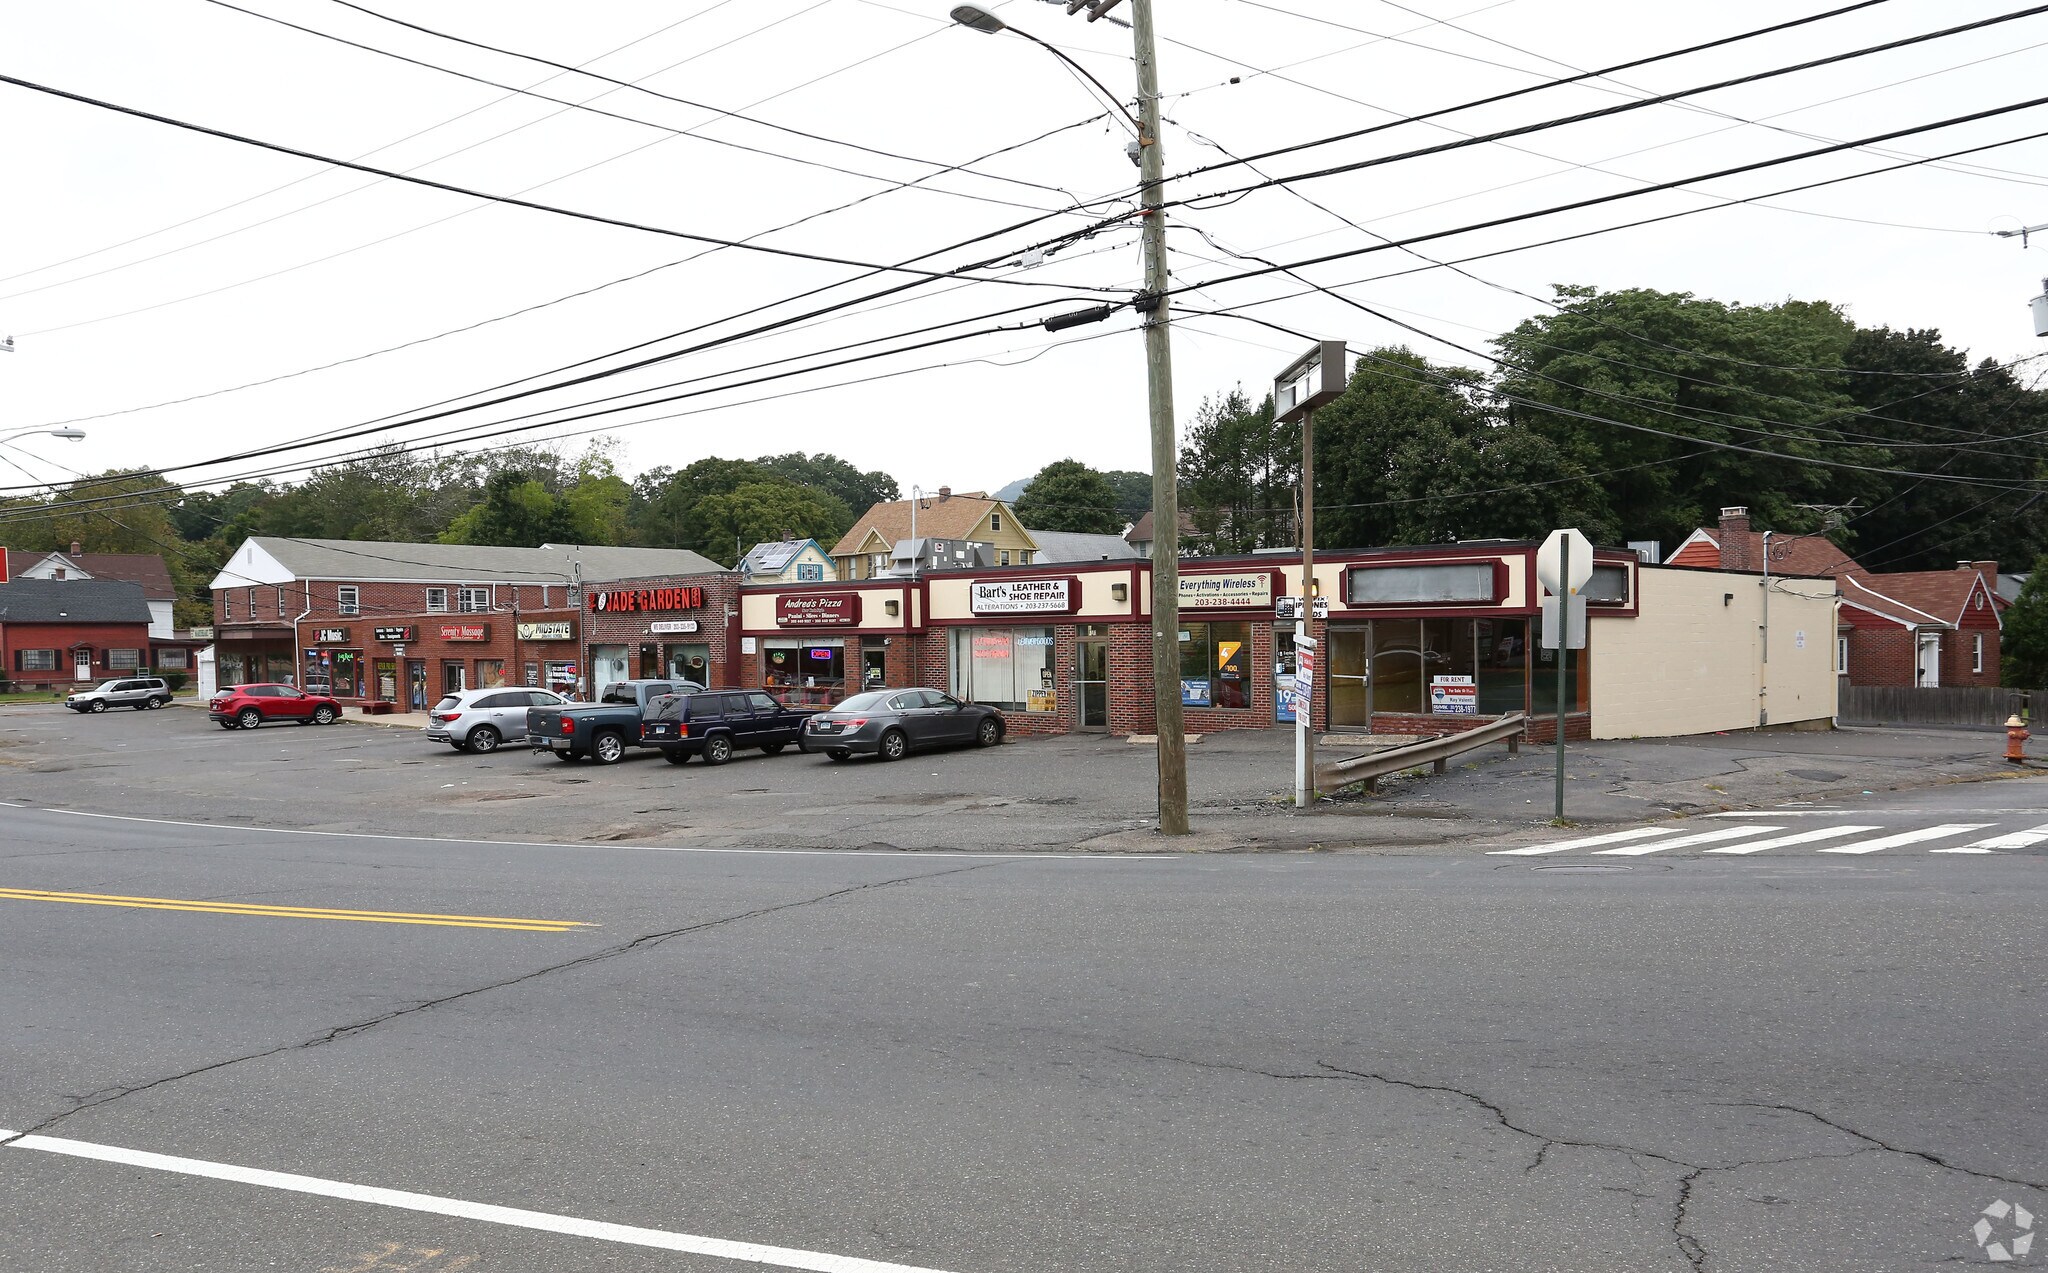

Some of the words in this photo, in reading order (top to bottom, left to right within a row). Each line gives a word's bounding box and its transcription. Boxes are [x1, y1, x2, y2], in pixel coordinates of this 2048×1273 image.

[1012, 582, 1051, 591] LEATHER
[1053, 582, 1059, 590] &
[1180, 580, 1220, 591] Everything
[1222, 579, 1256, 589] Wireless
[979, 586, 1007, 598] Bart's
[1034, 592, 1065, 600] REPAIR
[606, 591, 635, 611] JADE
[640, 588, 690, 611] GARDEN
[785, 599, 817, 609] Andrea's
[819, 598, 843, 607] Pizza
[1195, 598, 1251, 606] 203-238-4444
[441, 626, 460, 637] Serenity
[462, 626, 483, 639] Massage
[536, 623, 570, 634] MIDSTATE
[320, 630, 326, 641] JC
[327, 630, 342, 641] Music
